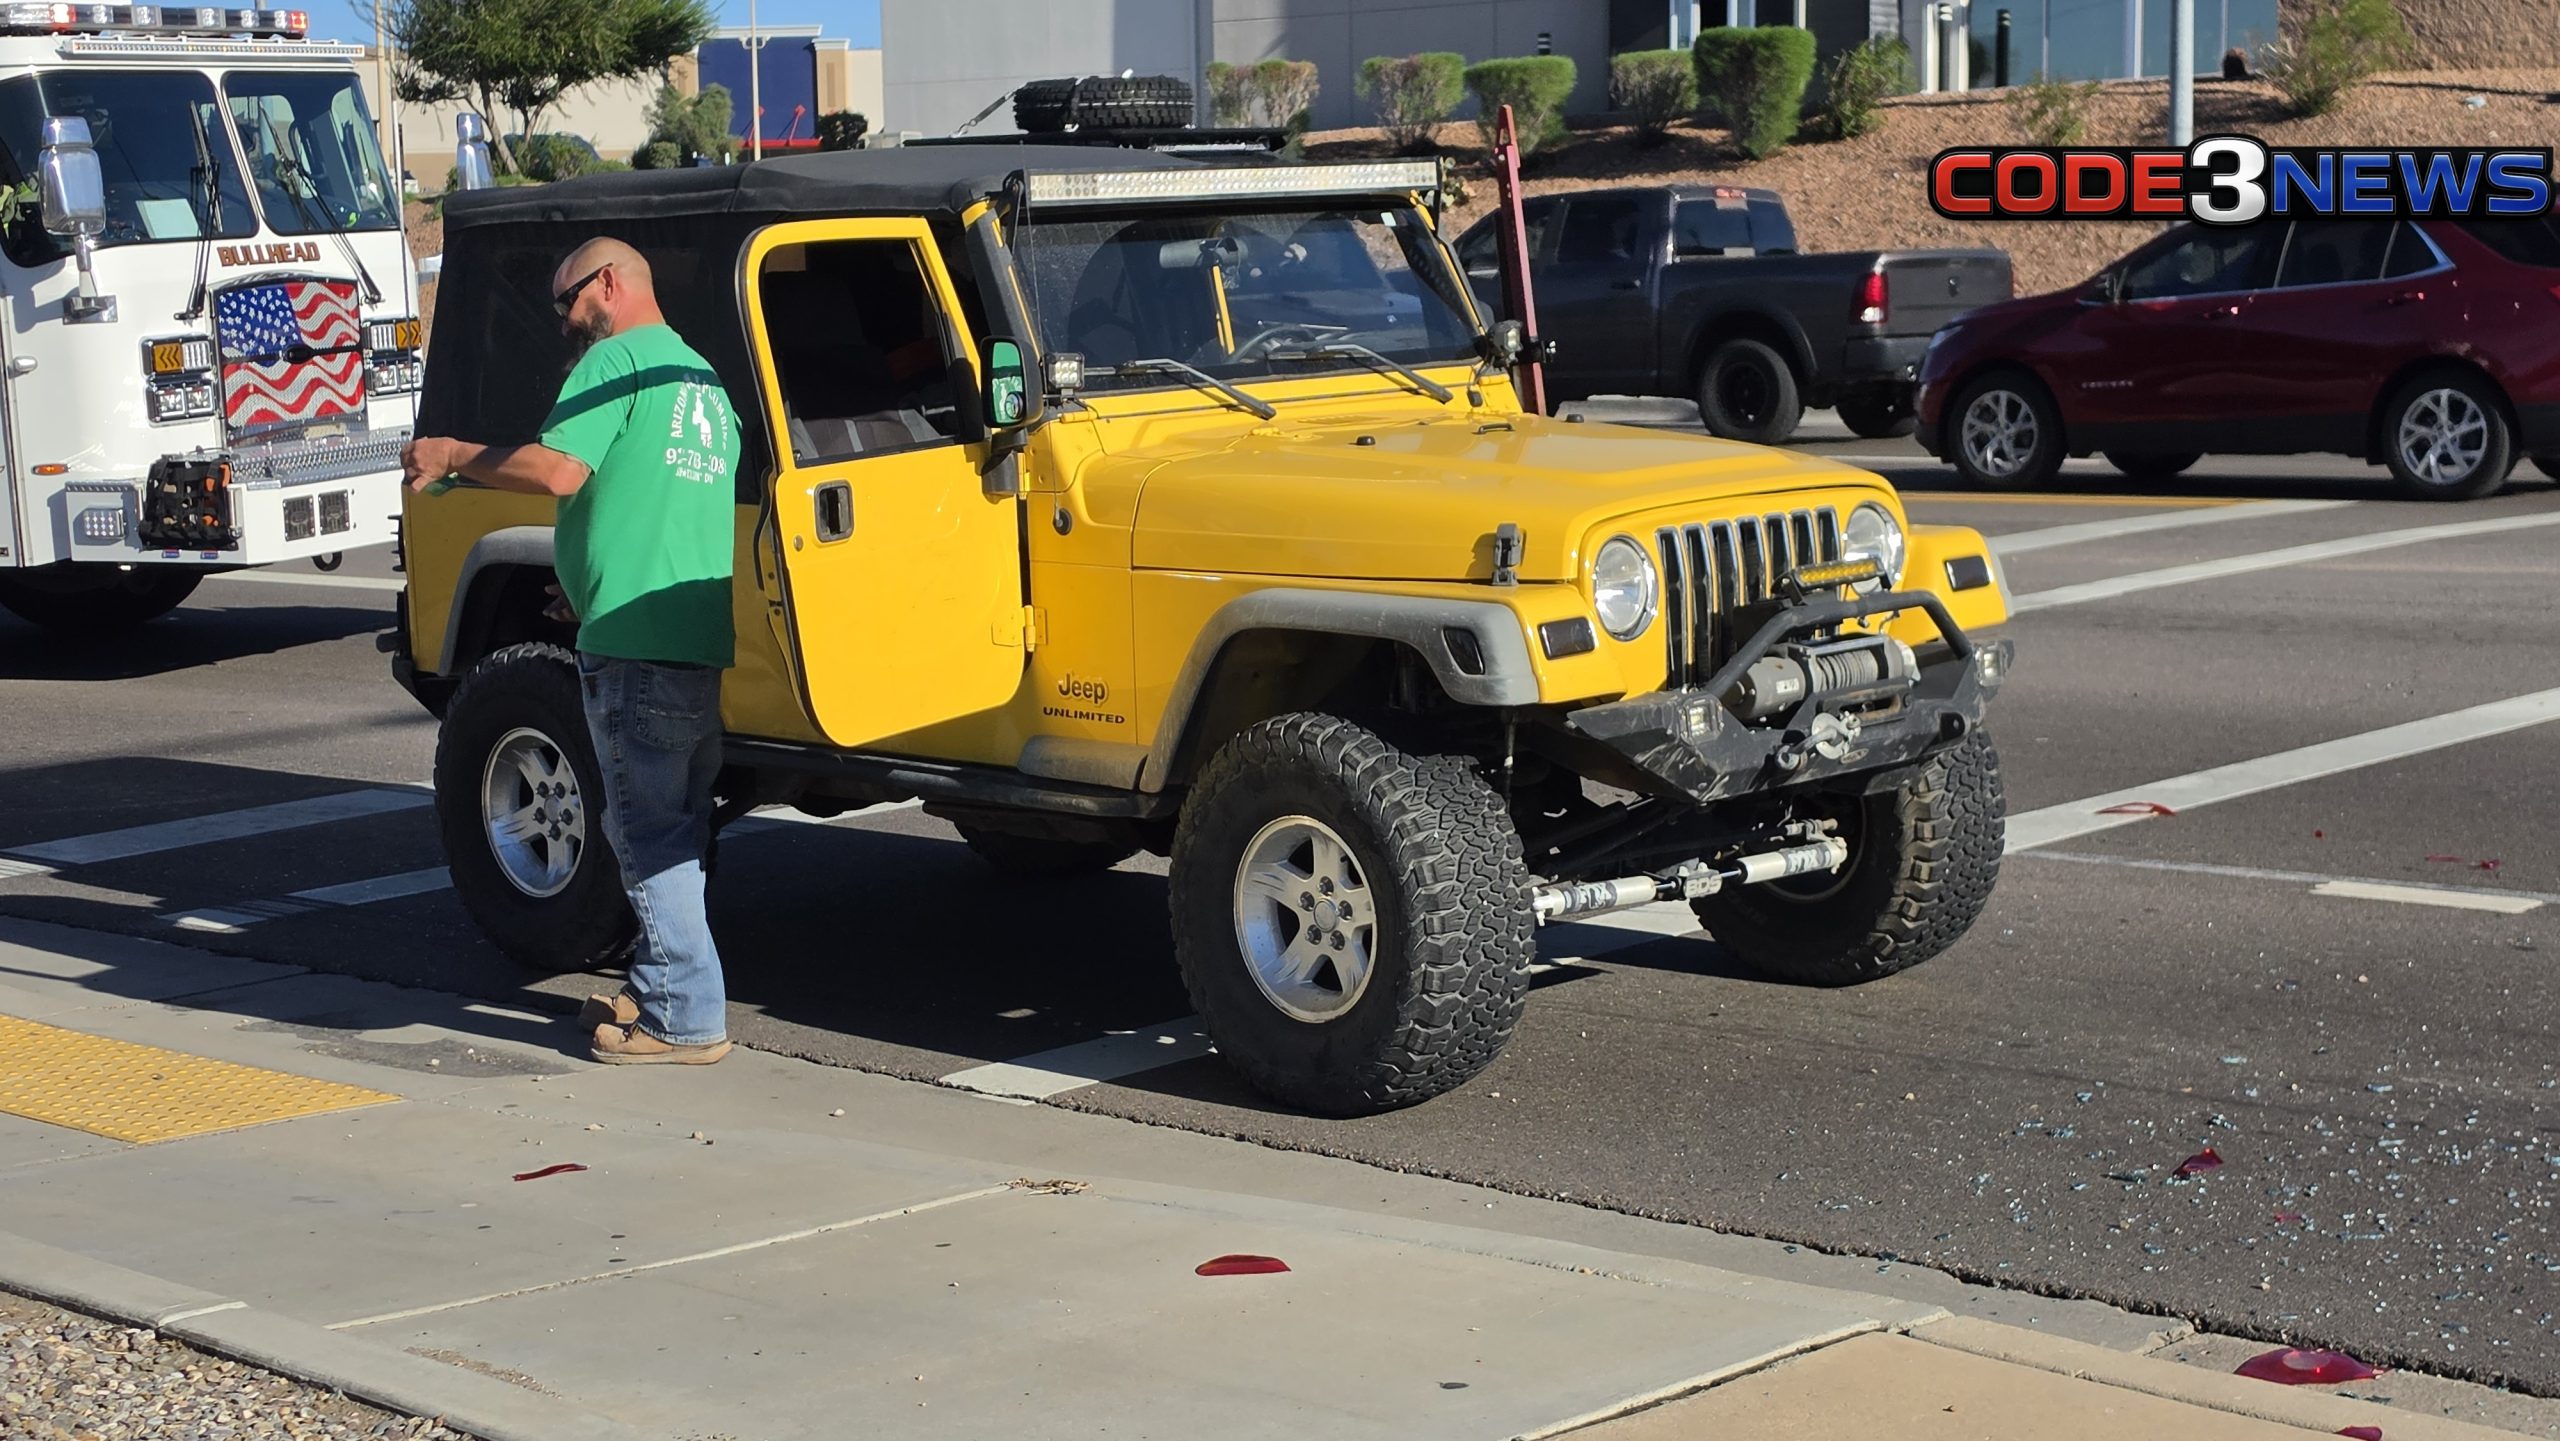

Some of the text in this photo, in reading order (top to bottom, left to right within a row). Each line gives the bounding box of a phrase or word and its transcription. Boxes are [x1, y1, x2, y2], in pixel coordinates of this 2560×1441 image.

[217, 241, 321, 267] BULLHEAD
[1058, 672, 1106, 704] Jeep
[1043, 706, 1126, 724] UNLIMITED
